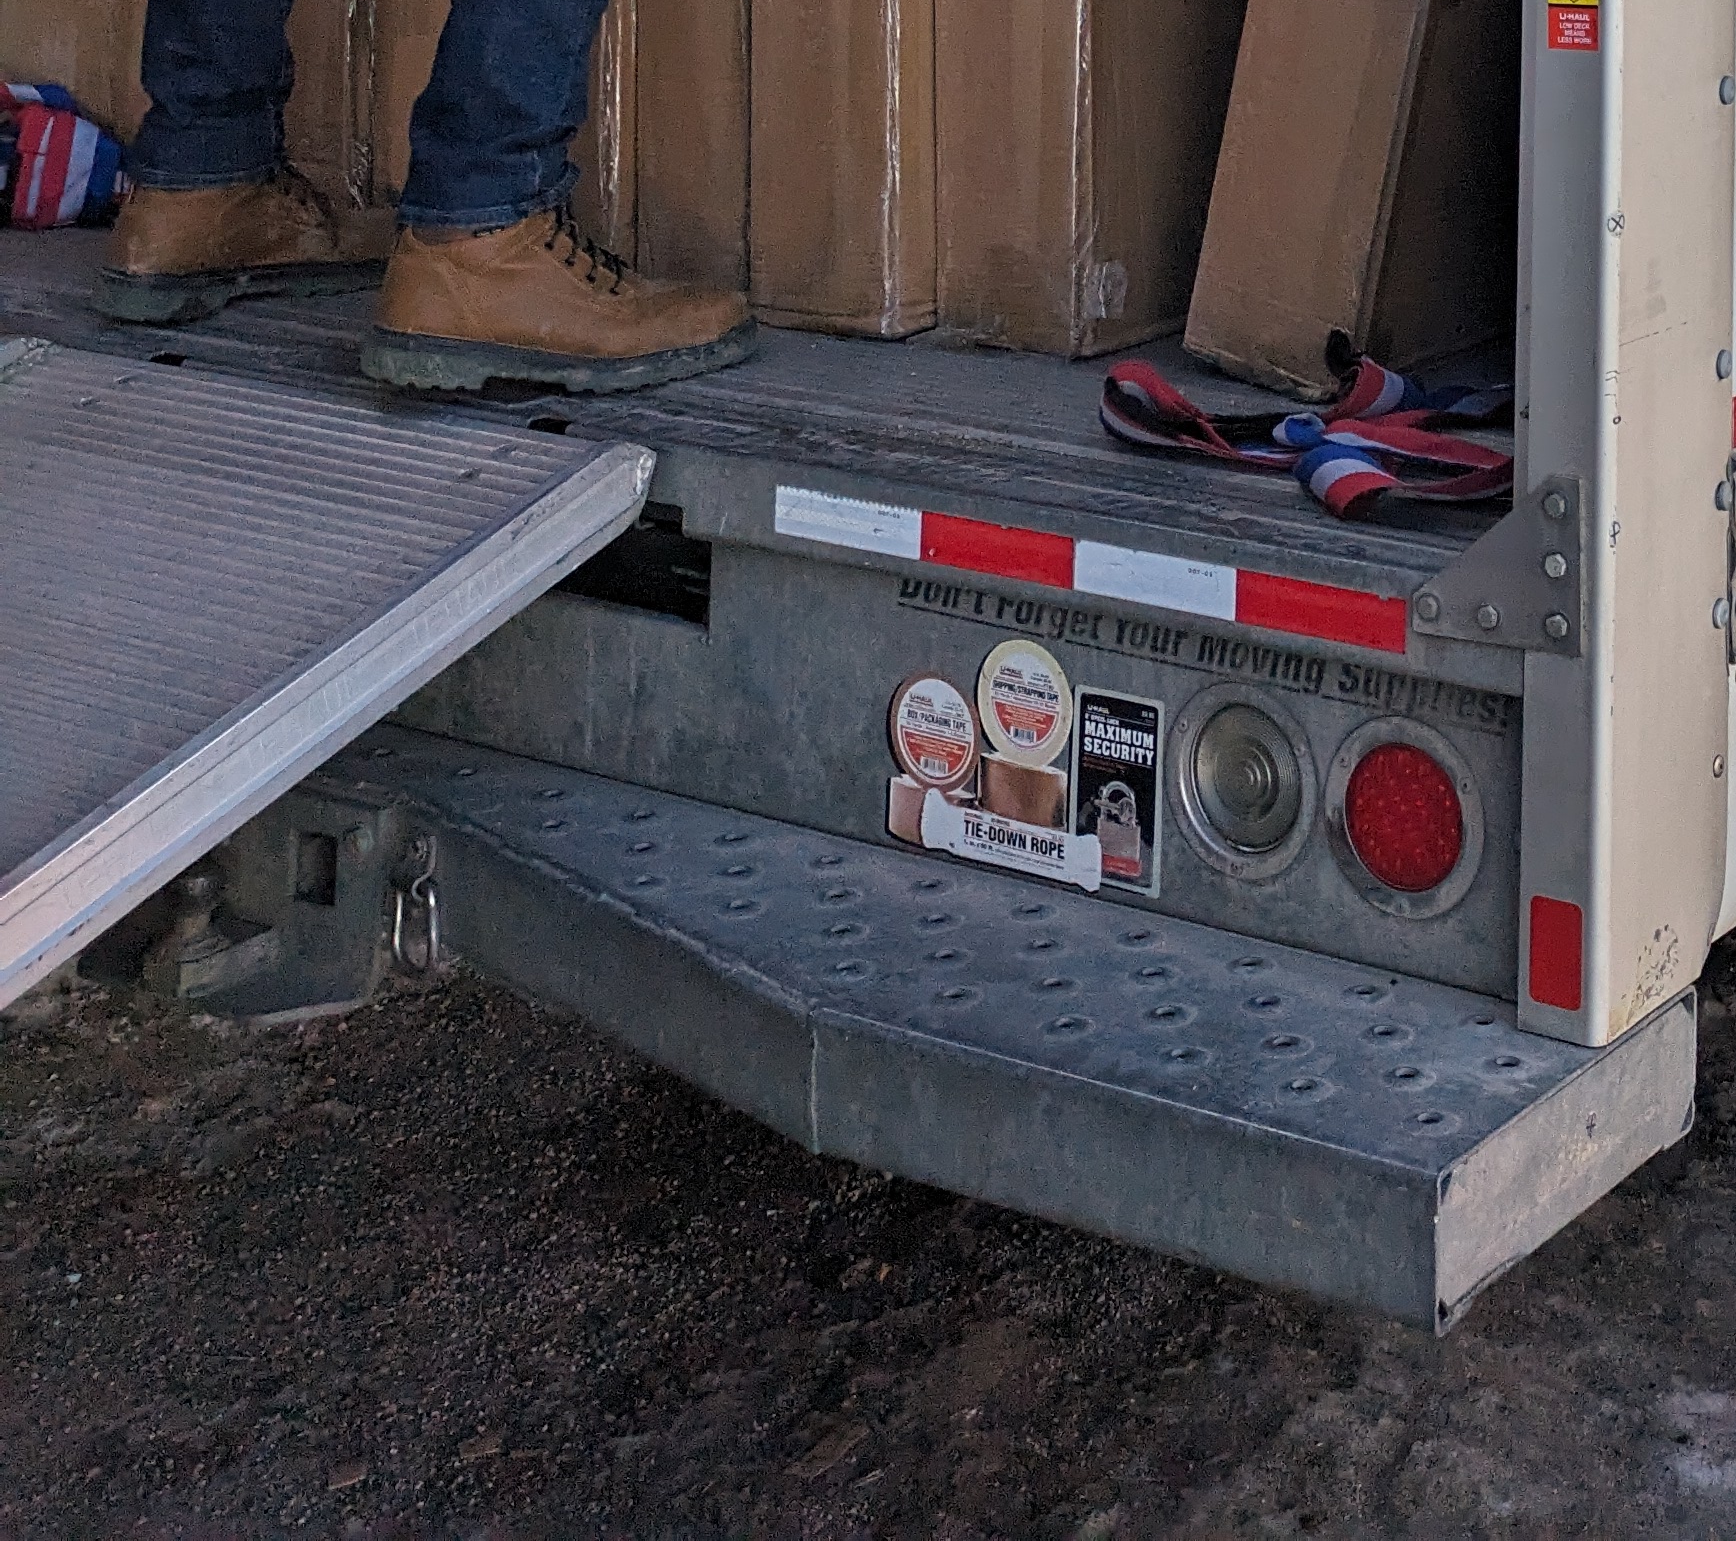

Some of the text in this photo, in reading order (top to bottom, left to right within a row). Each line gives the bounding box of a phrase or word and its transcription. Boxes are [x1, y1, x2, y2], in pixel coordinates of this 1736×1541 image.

[1197, 635, 1323, 694] Moving
[1084, 737, 1154, 765] SECURITY
[1085, 720, 1154, 749] MAXIMUM
[964, 820, 1026, 850] TIE-DOWN
[1031, 837, 1065, 860] ROPE
